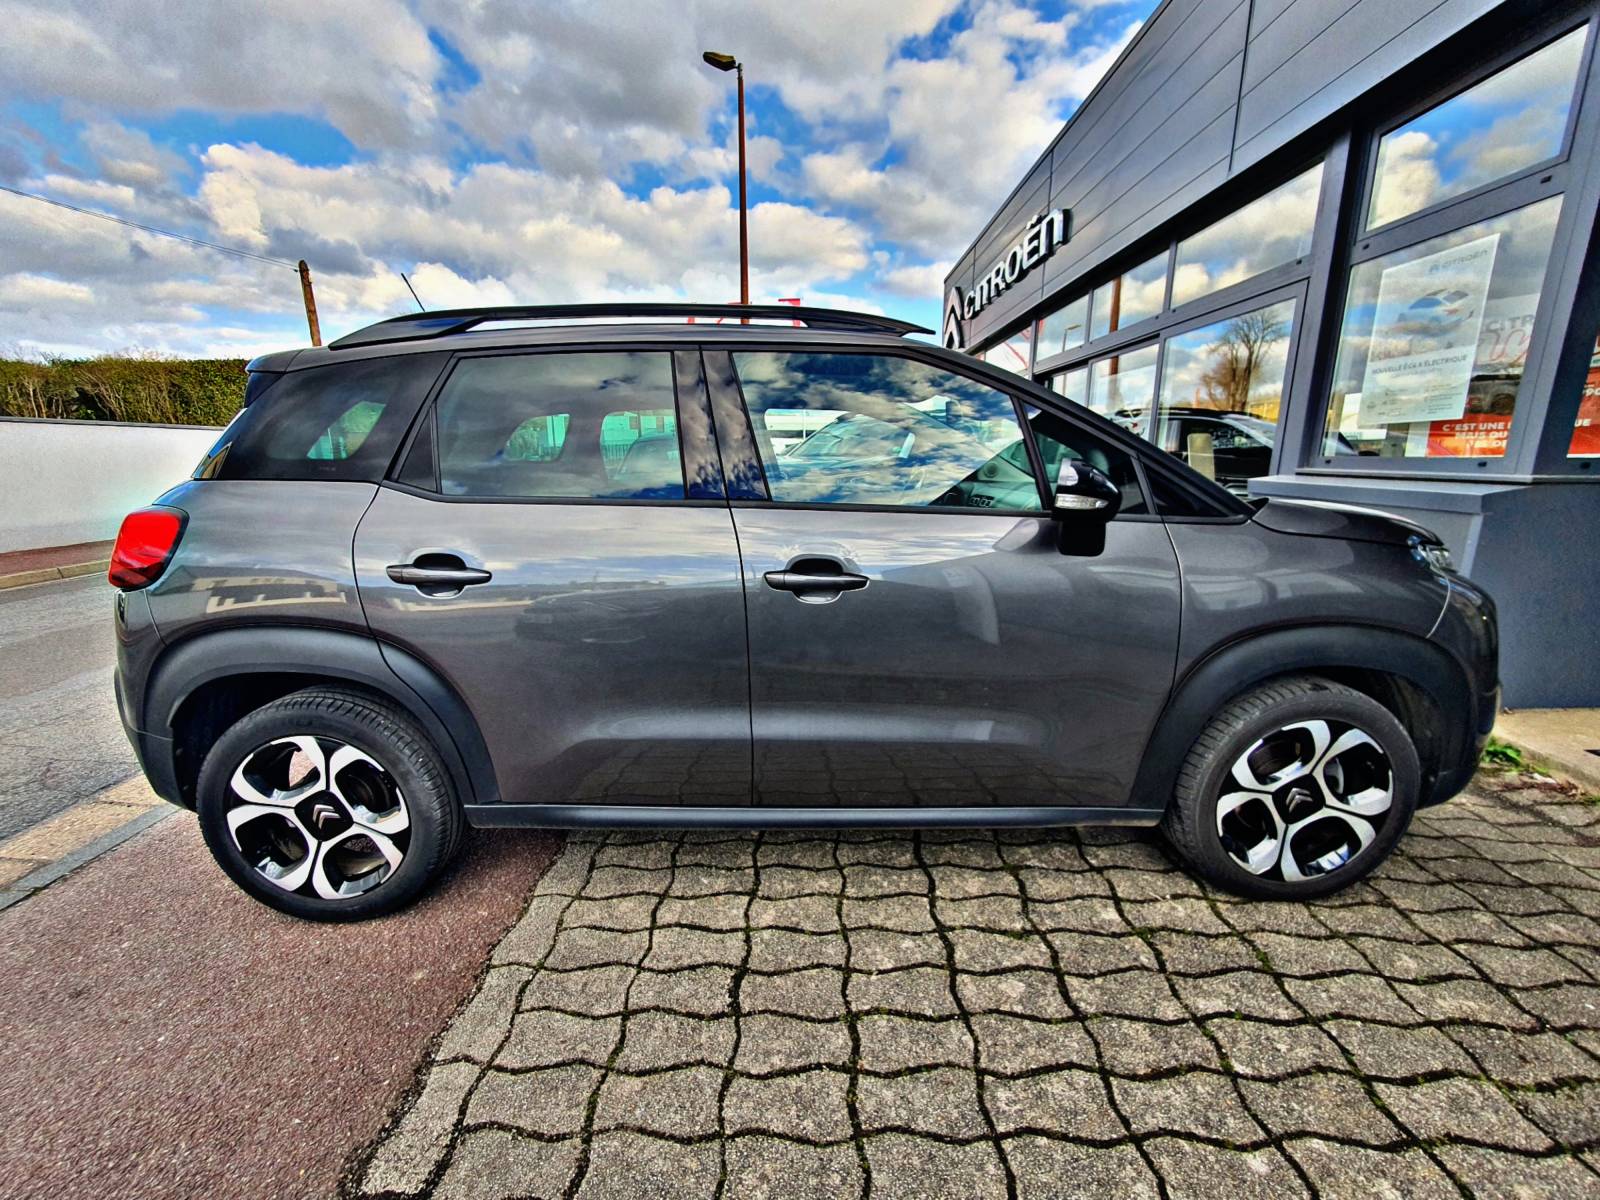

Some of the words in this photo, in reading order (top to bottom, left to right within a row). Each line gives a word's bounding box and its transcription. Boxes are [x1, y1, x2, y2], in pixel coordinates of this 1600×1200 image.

[1485, 314, 1535, 332] CITR
[1479, 422, 1505, 430] UNE
[1455, 431, 1487, 440] MAIS
[1489, 431, 1508, 439] QU
